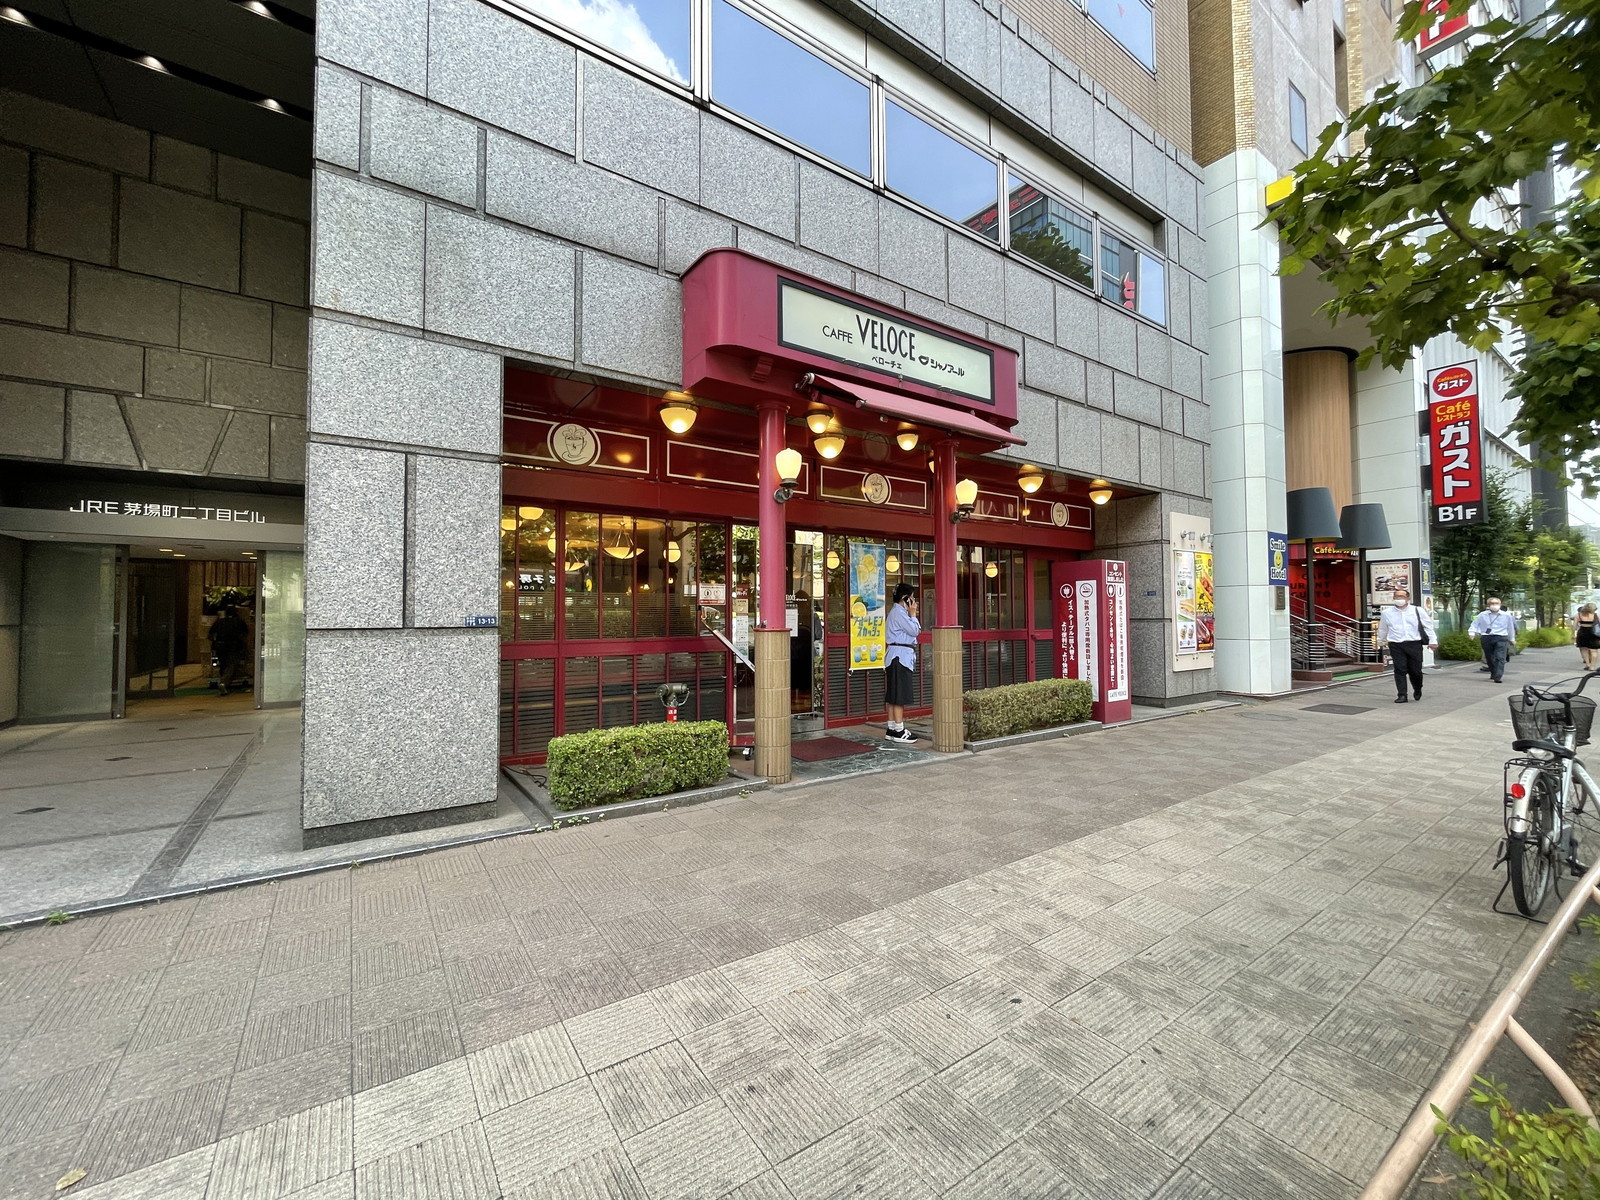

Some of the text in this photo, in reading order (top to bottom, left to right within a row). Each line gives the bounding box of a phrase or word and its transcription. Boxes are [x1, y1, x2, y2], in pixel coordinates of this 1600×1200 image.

[822, 314, 916, 361] CAFFE VELOCE
[871, 356, 903, 370] ベローチェ
[929, 357, 965, 377] シャノアール
[1437, 379, 1469, 392] ガスト
[1435, 400, 1471, 416] Café
[1436, 411, 1471, 423] レストラン
[1439, 420, 1470, 498] ガスト
[70, 499, 266, 524] JRE 茅場町二丁目ビル
[1438, 505, 1477, 523] B1F
[1269, 538, 1286, 551] Smile
[1270, 568, 1287, 581] Hotel
